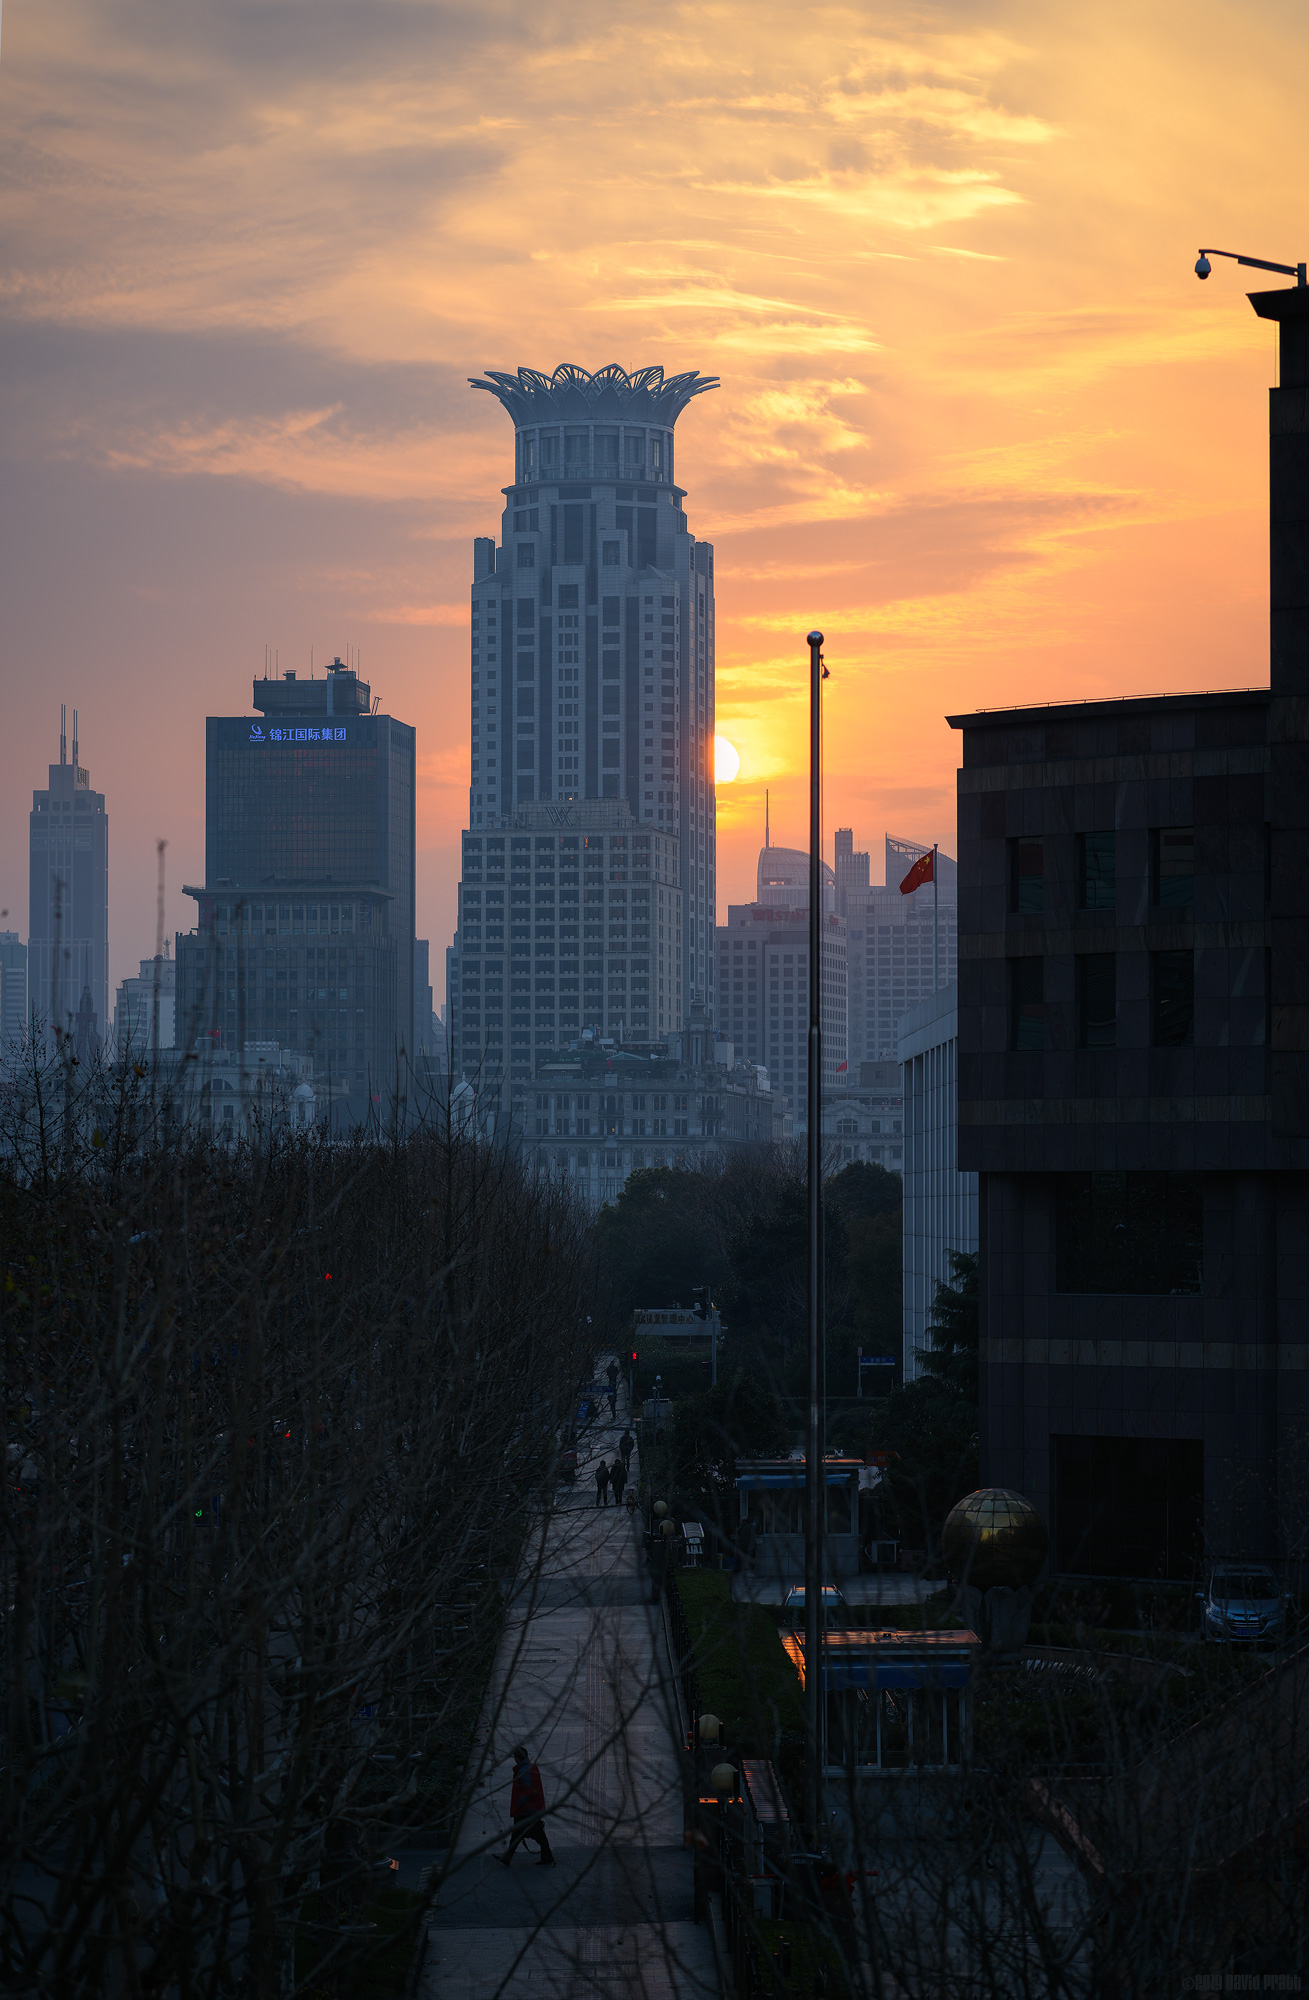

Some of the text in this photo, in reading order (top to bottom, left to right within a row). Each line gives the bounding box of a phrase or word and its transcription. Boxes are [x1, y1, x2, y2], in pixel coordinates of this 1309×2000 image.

[269, 728, 346, 741] 锦江国际集团
